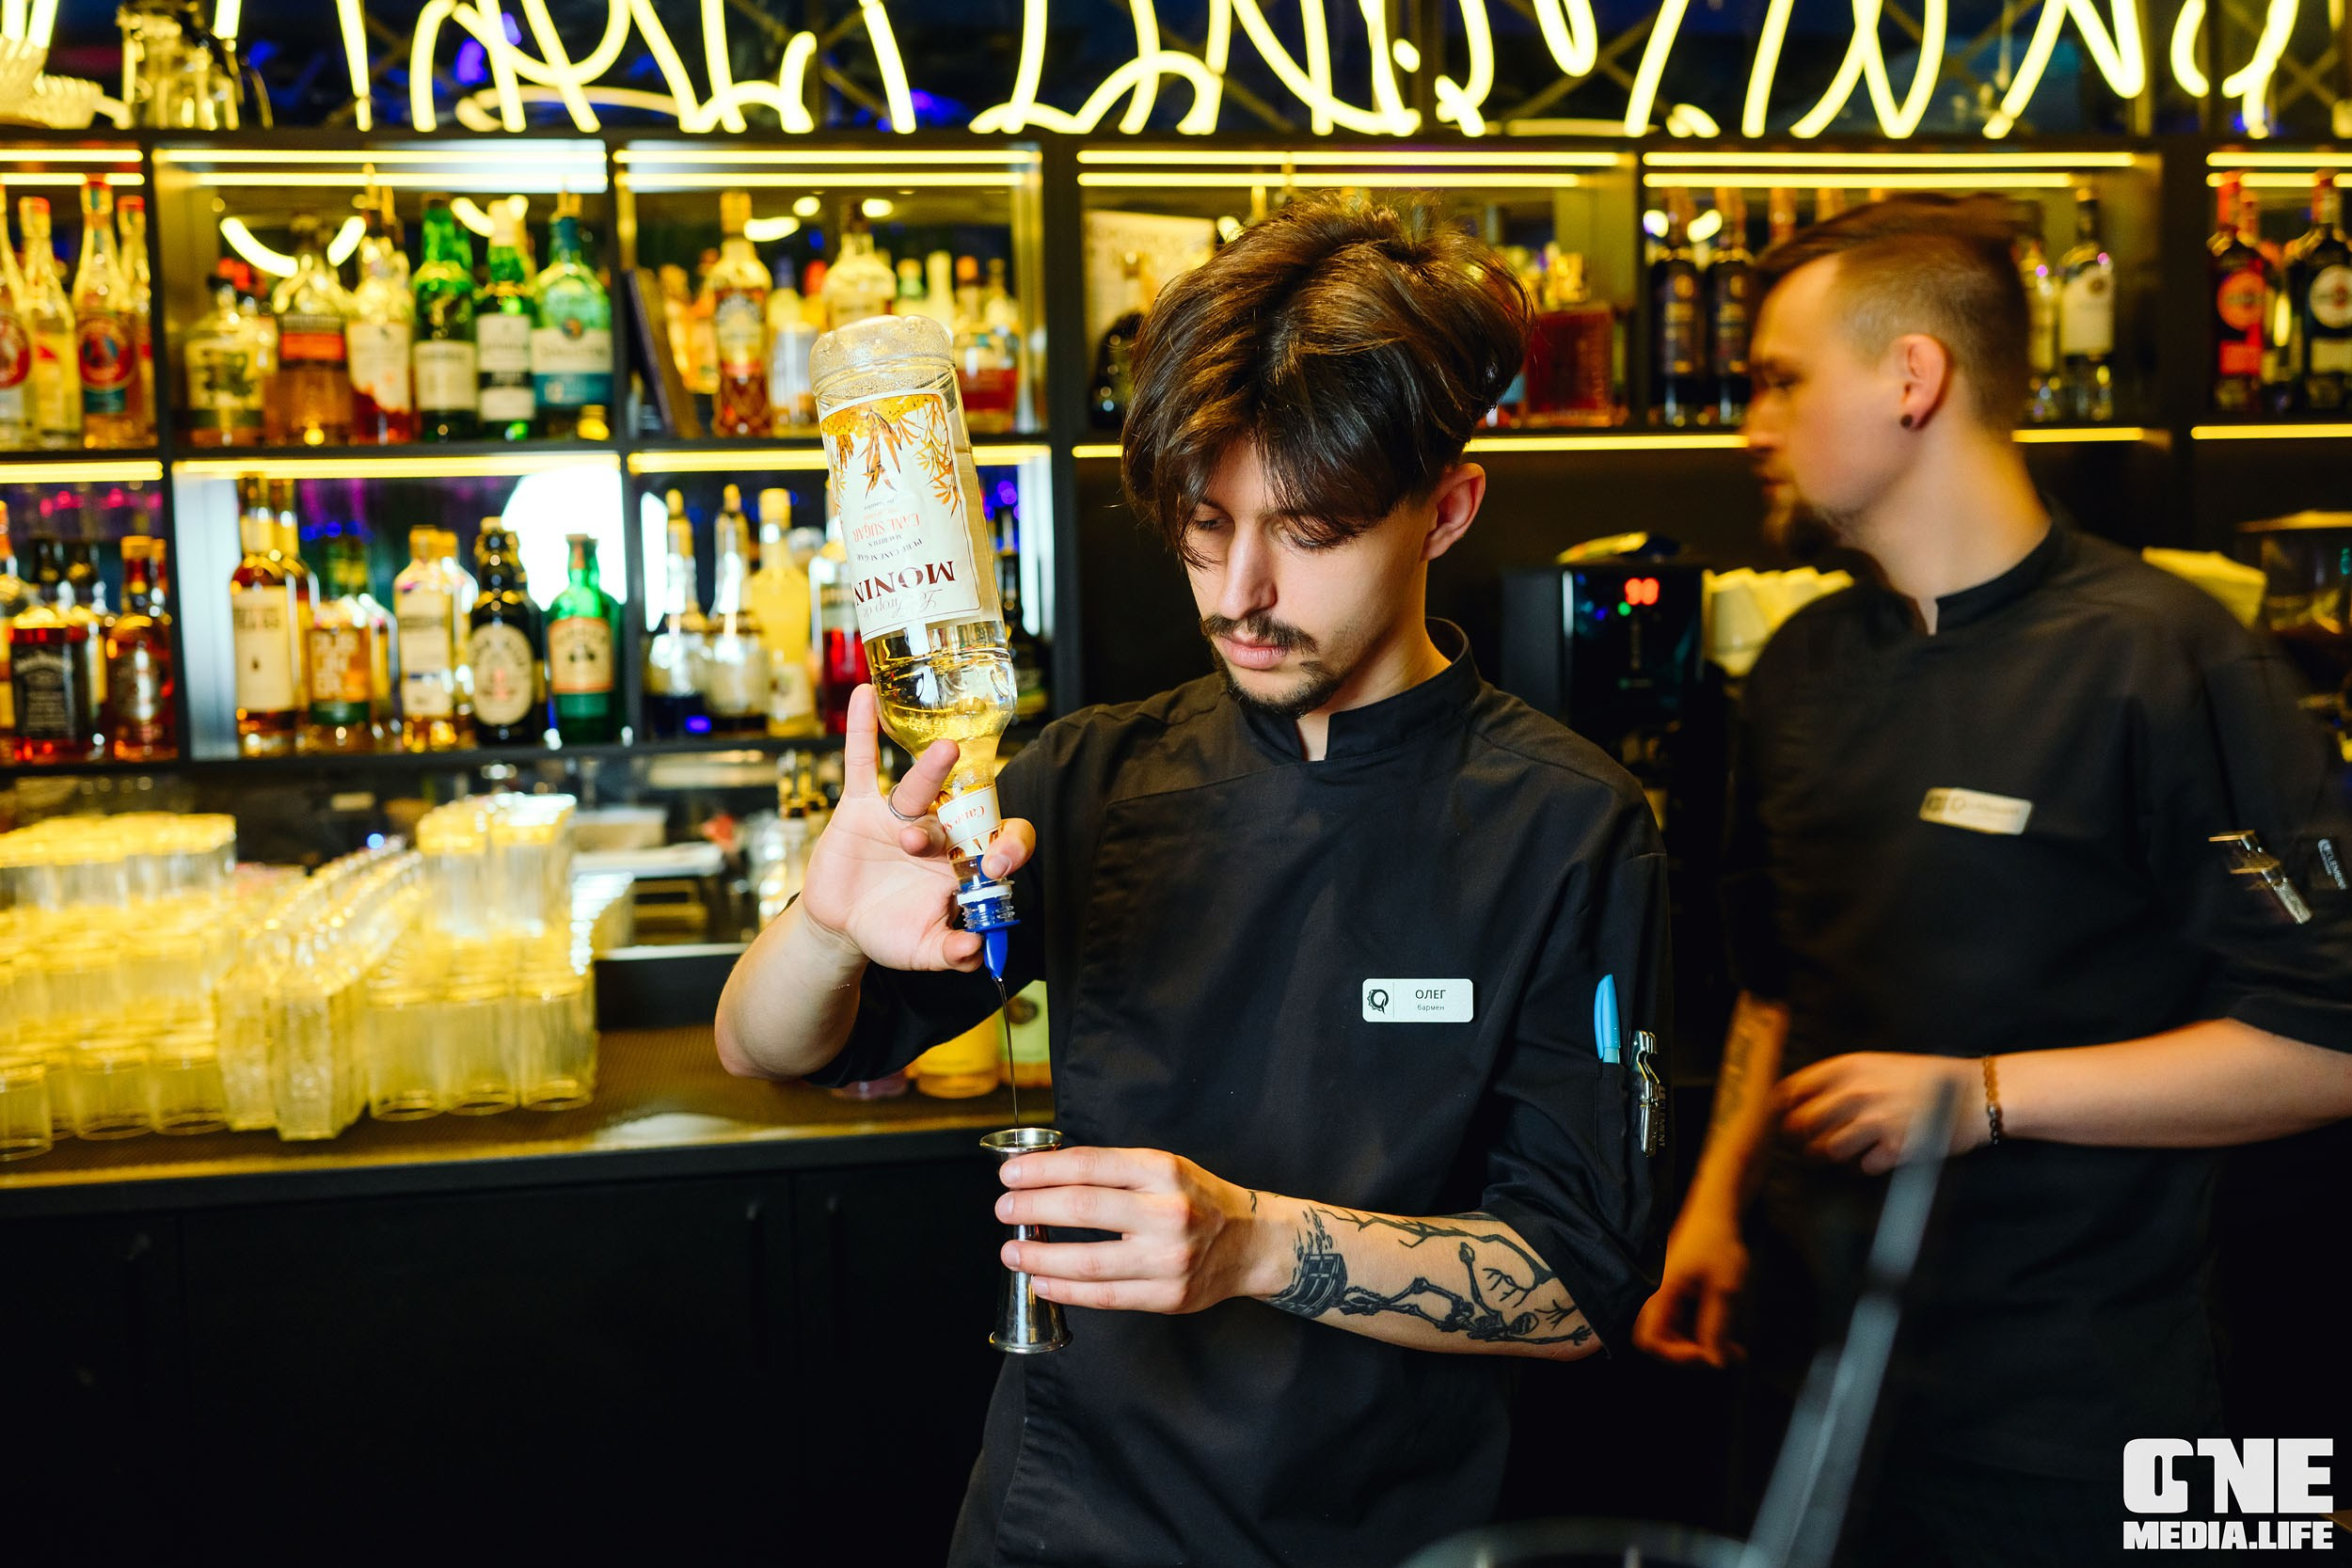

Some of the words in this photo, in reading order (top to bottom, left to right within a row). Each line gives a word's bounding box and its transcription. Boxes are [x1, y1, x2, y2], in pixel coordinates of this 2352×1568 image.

[852, 522, 884, 543] SUGAR
[854, 561, 956, 607] MONIN
[1415, 989, 1447, 1000] ОЛЕГ
[1417, 1004, 1445, 1012] бармен
